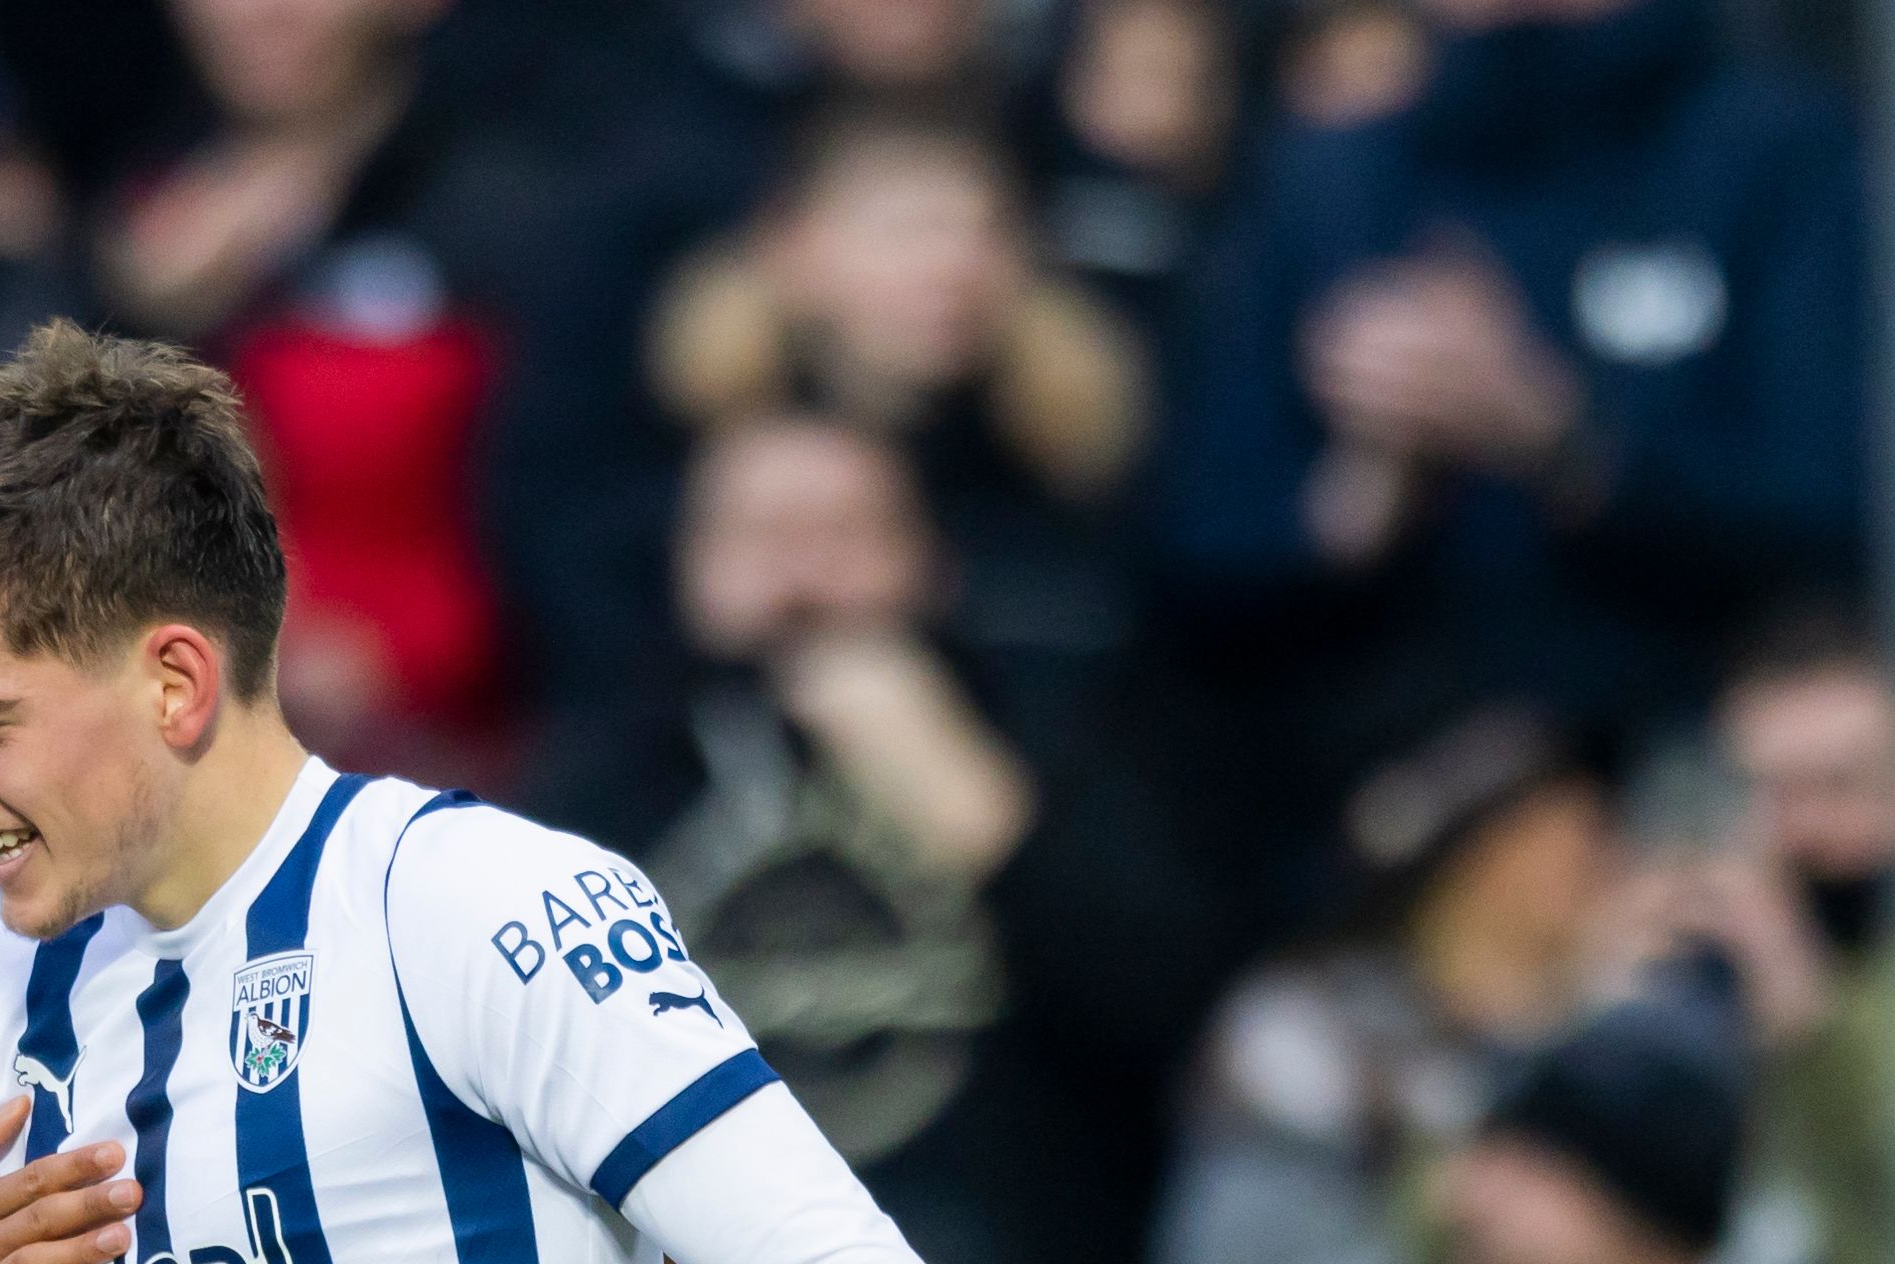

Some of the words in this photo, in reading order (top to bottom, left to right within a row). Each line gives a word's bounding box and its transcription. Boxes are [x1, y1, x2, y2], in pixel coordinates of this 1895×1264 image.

[236, 971, 259, 985] WEST
[261, 959, 308, 979] BROMWICH
[562, 911, 687, 1005] BOS
[236, 970, 307, 1006] ALBION
